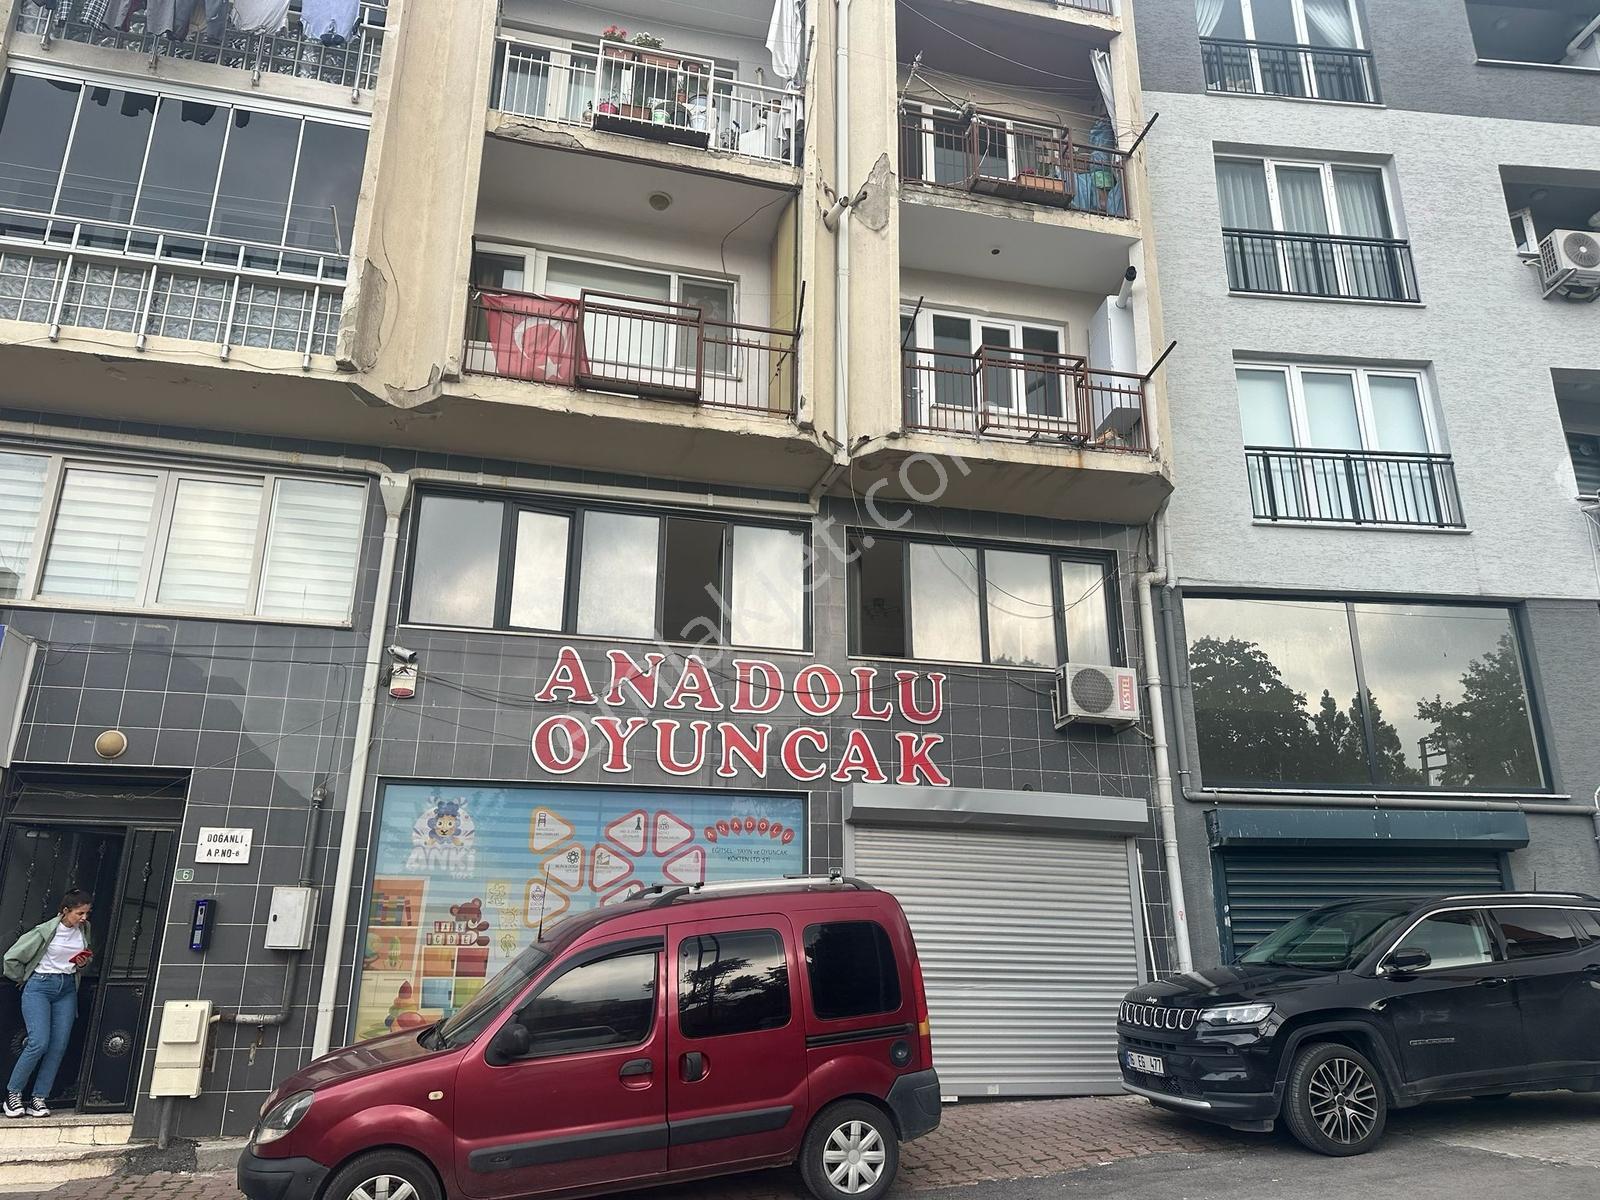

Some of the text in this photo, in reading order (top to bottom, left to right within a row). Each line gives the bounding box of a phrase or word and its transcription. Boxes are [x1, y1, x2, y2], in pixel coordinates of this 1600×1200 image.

[535, 646, 946, 724] ANADOLU
[1123, 676, 1131, 710] VESTEL
[532, 715, 951, 786] OYUNCAK
[706, 820, 792, 841] ANADOLU
[182, 870, 191, 880] 6
